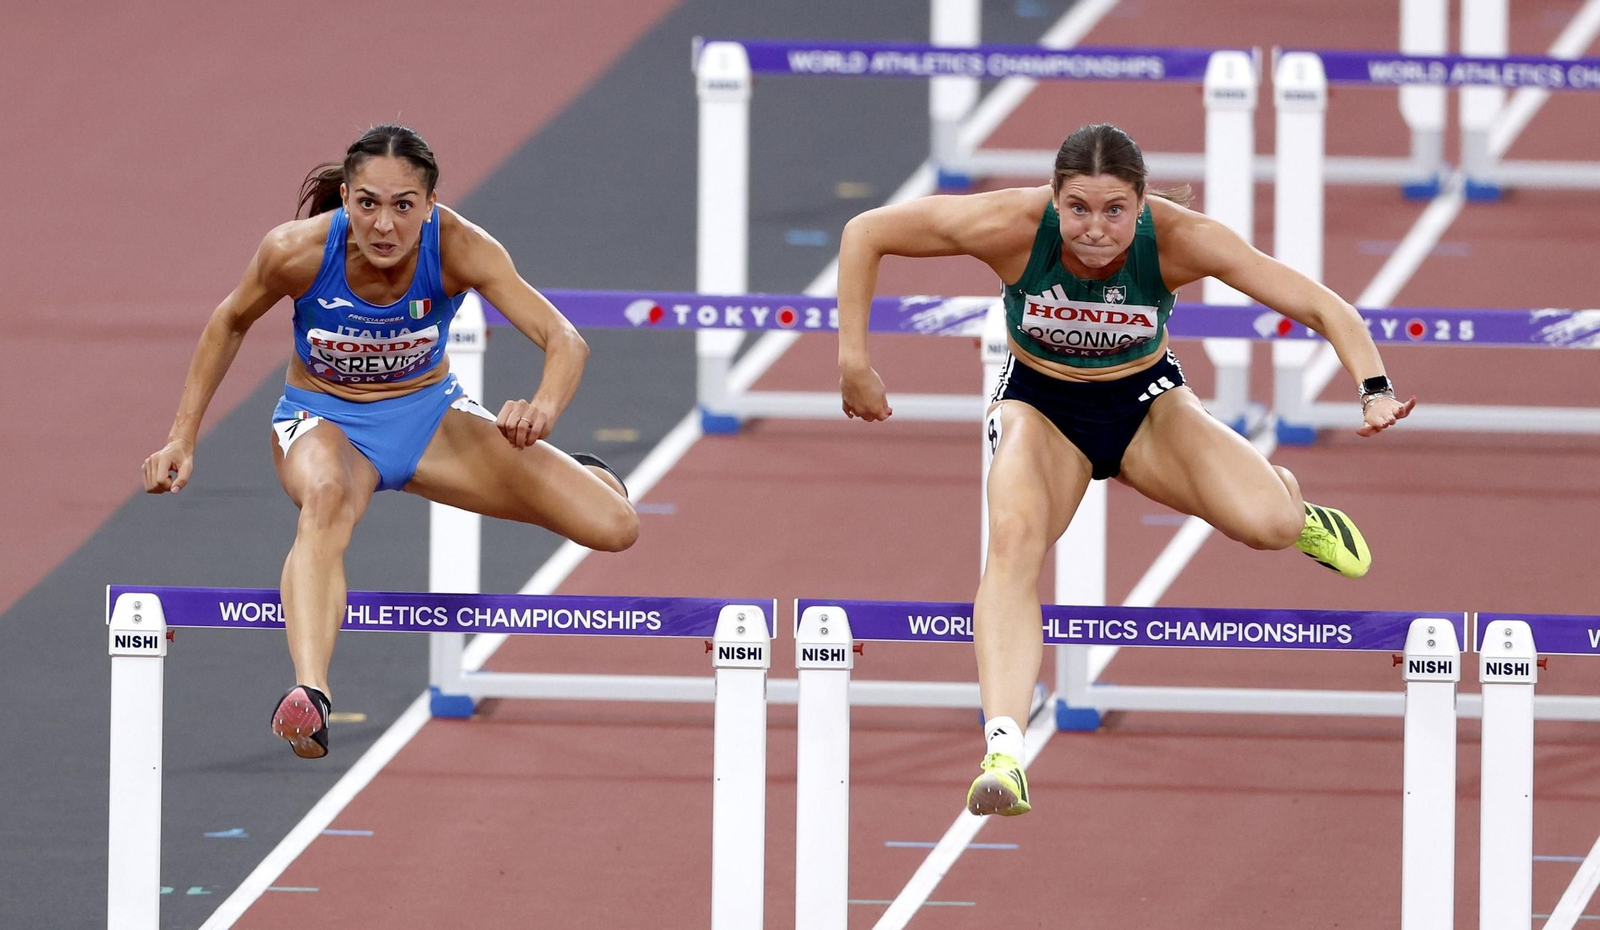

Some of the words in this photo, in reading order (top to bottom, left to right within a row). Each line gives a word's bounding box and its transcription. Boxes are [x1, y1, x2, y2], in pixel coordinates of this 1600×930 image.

[1027, 302, 1154, 328] HONDA
[336, 324, 412, 339] ITALIA
[1433, 319, 1475, 341] 25
[310, 336, 433, 353] HONDA
[219, 602, 286, 623] WORL
[345, 604, 449, 626] HLETICS
[456, 607, 662, 631] CHAMPIONSHIPS
[908, 615, 974, 636] WORL
[1042, 618, 1138, 640] HLETICS
[1145, 620, 1353, 644] CHAMPIONSHIPS
[114, 634, 158, 649] NISHI
[718, 646, 763, 661] NISHI
[802, 648, 846, 662] NISHI
[1408, 660, 1453, 674] NISHI
[1485, 662, 1530, 676] NISHI
